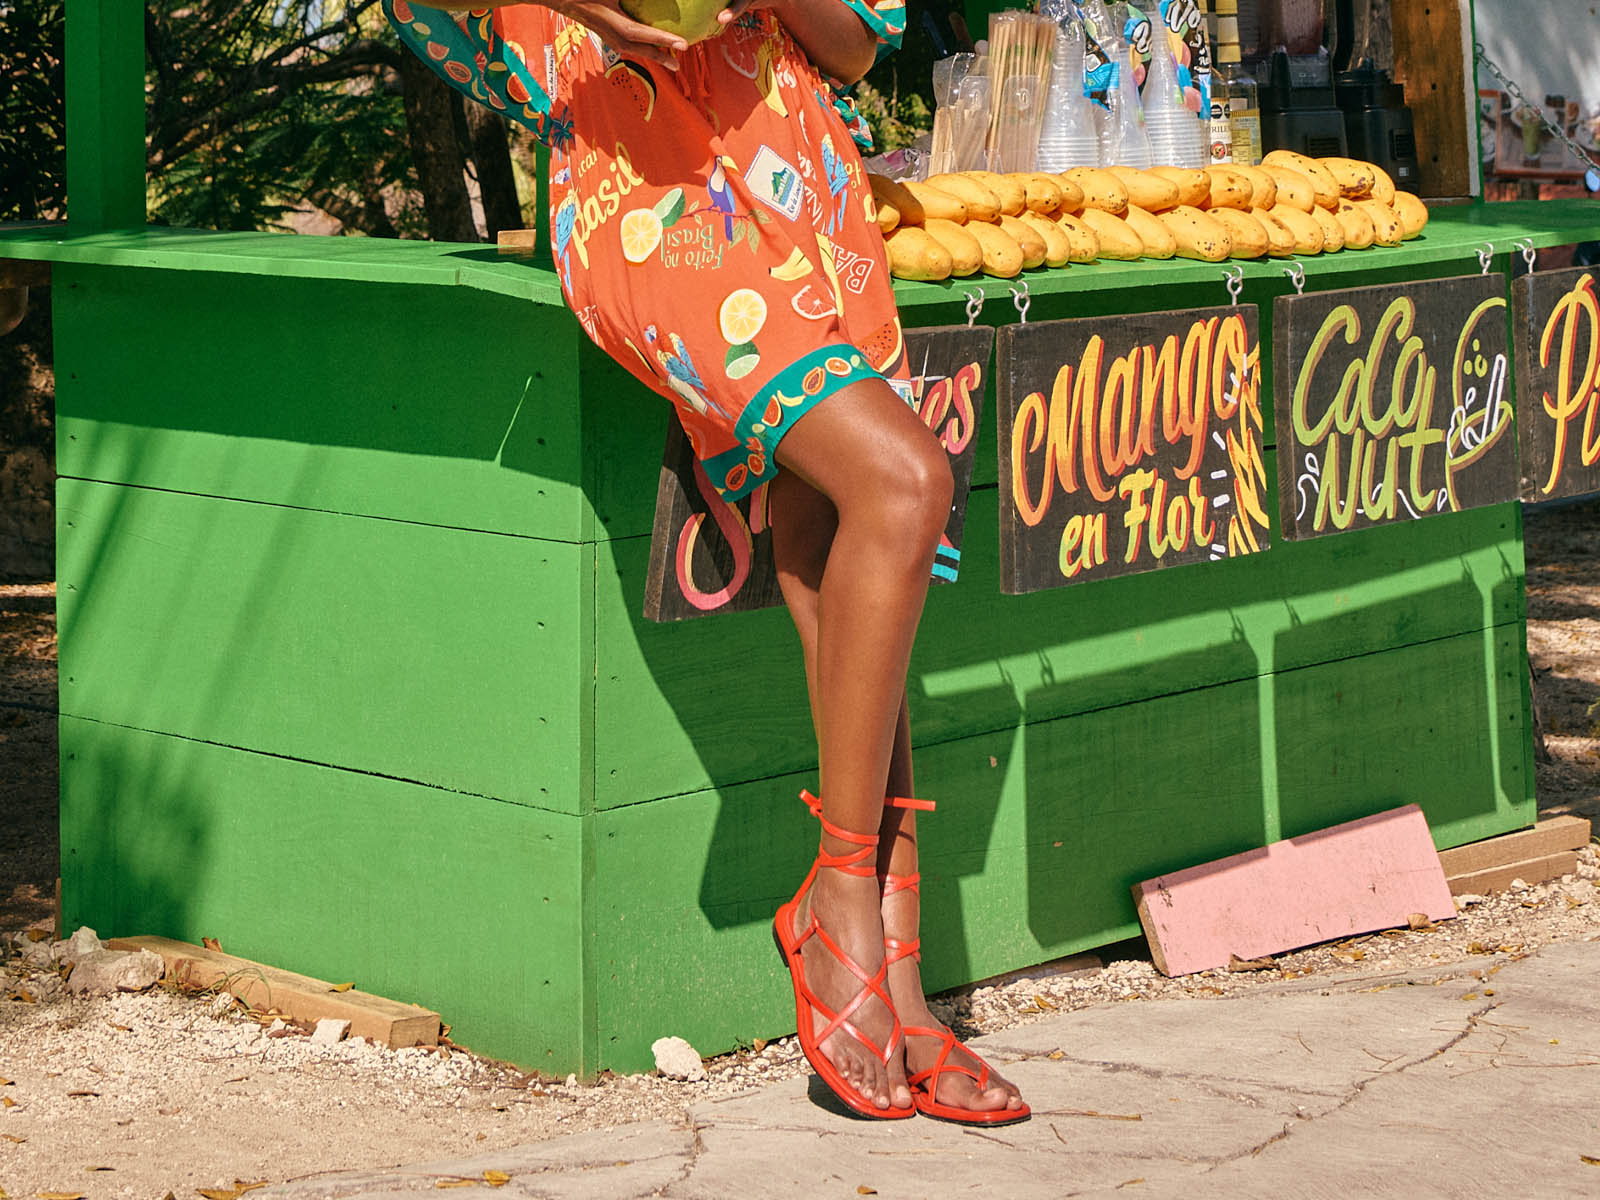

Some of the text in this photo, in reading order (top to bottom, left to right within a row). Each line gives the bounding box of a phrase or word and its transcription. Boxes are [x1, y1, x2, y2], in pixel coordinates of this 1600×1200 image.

[660, 224, 714, 262] Brasil
[1011, 313, 1259, 527] Mango
[1059, 467, 1216, 578] en Flor
